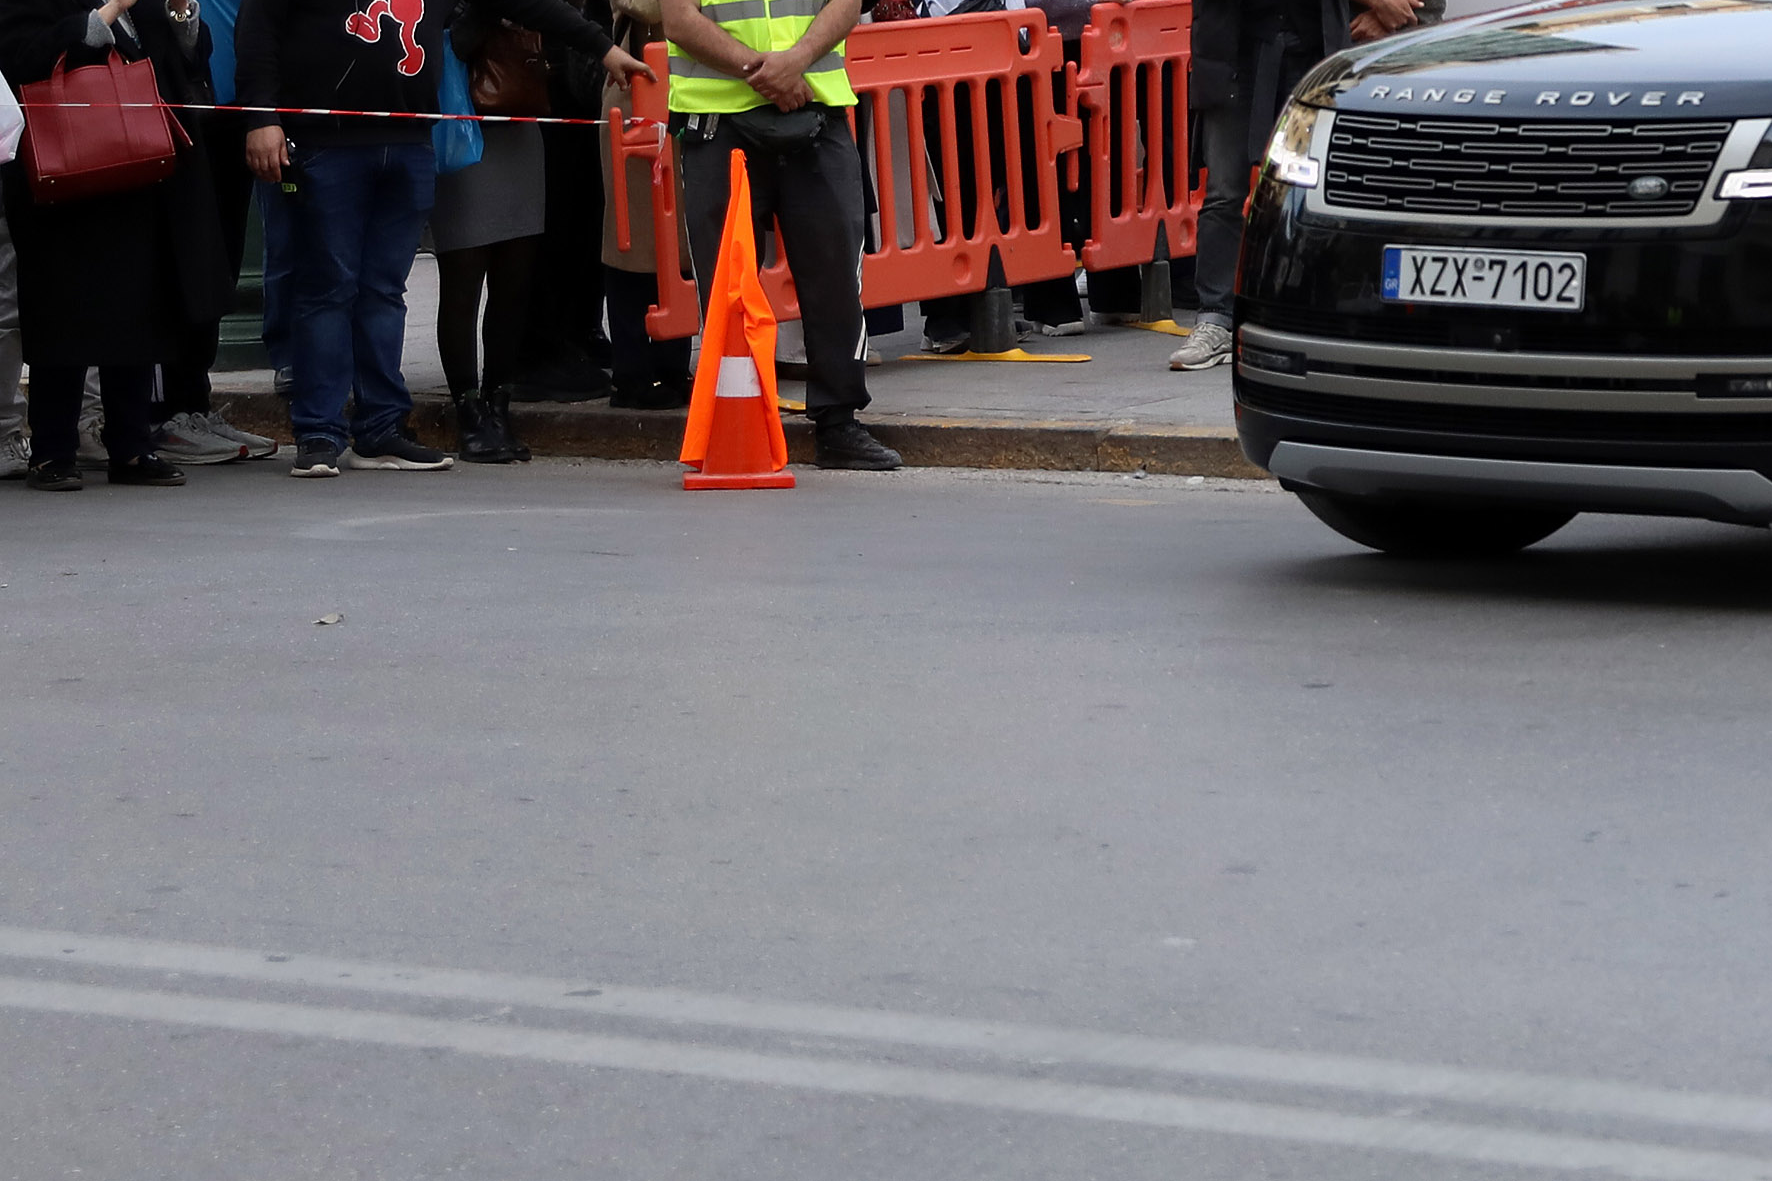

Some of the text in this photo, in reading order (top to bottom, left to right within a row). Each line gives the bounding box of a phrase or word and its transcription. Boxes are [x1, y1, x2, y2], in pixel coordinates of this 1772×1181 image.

[1369, 85, 1706, 107] RANGE ROVER
[1384, 278, 1399, 291] GR
